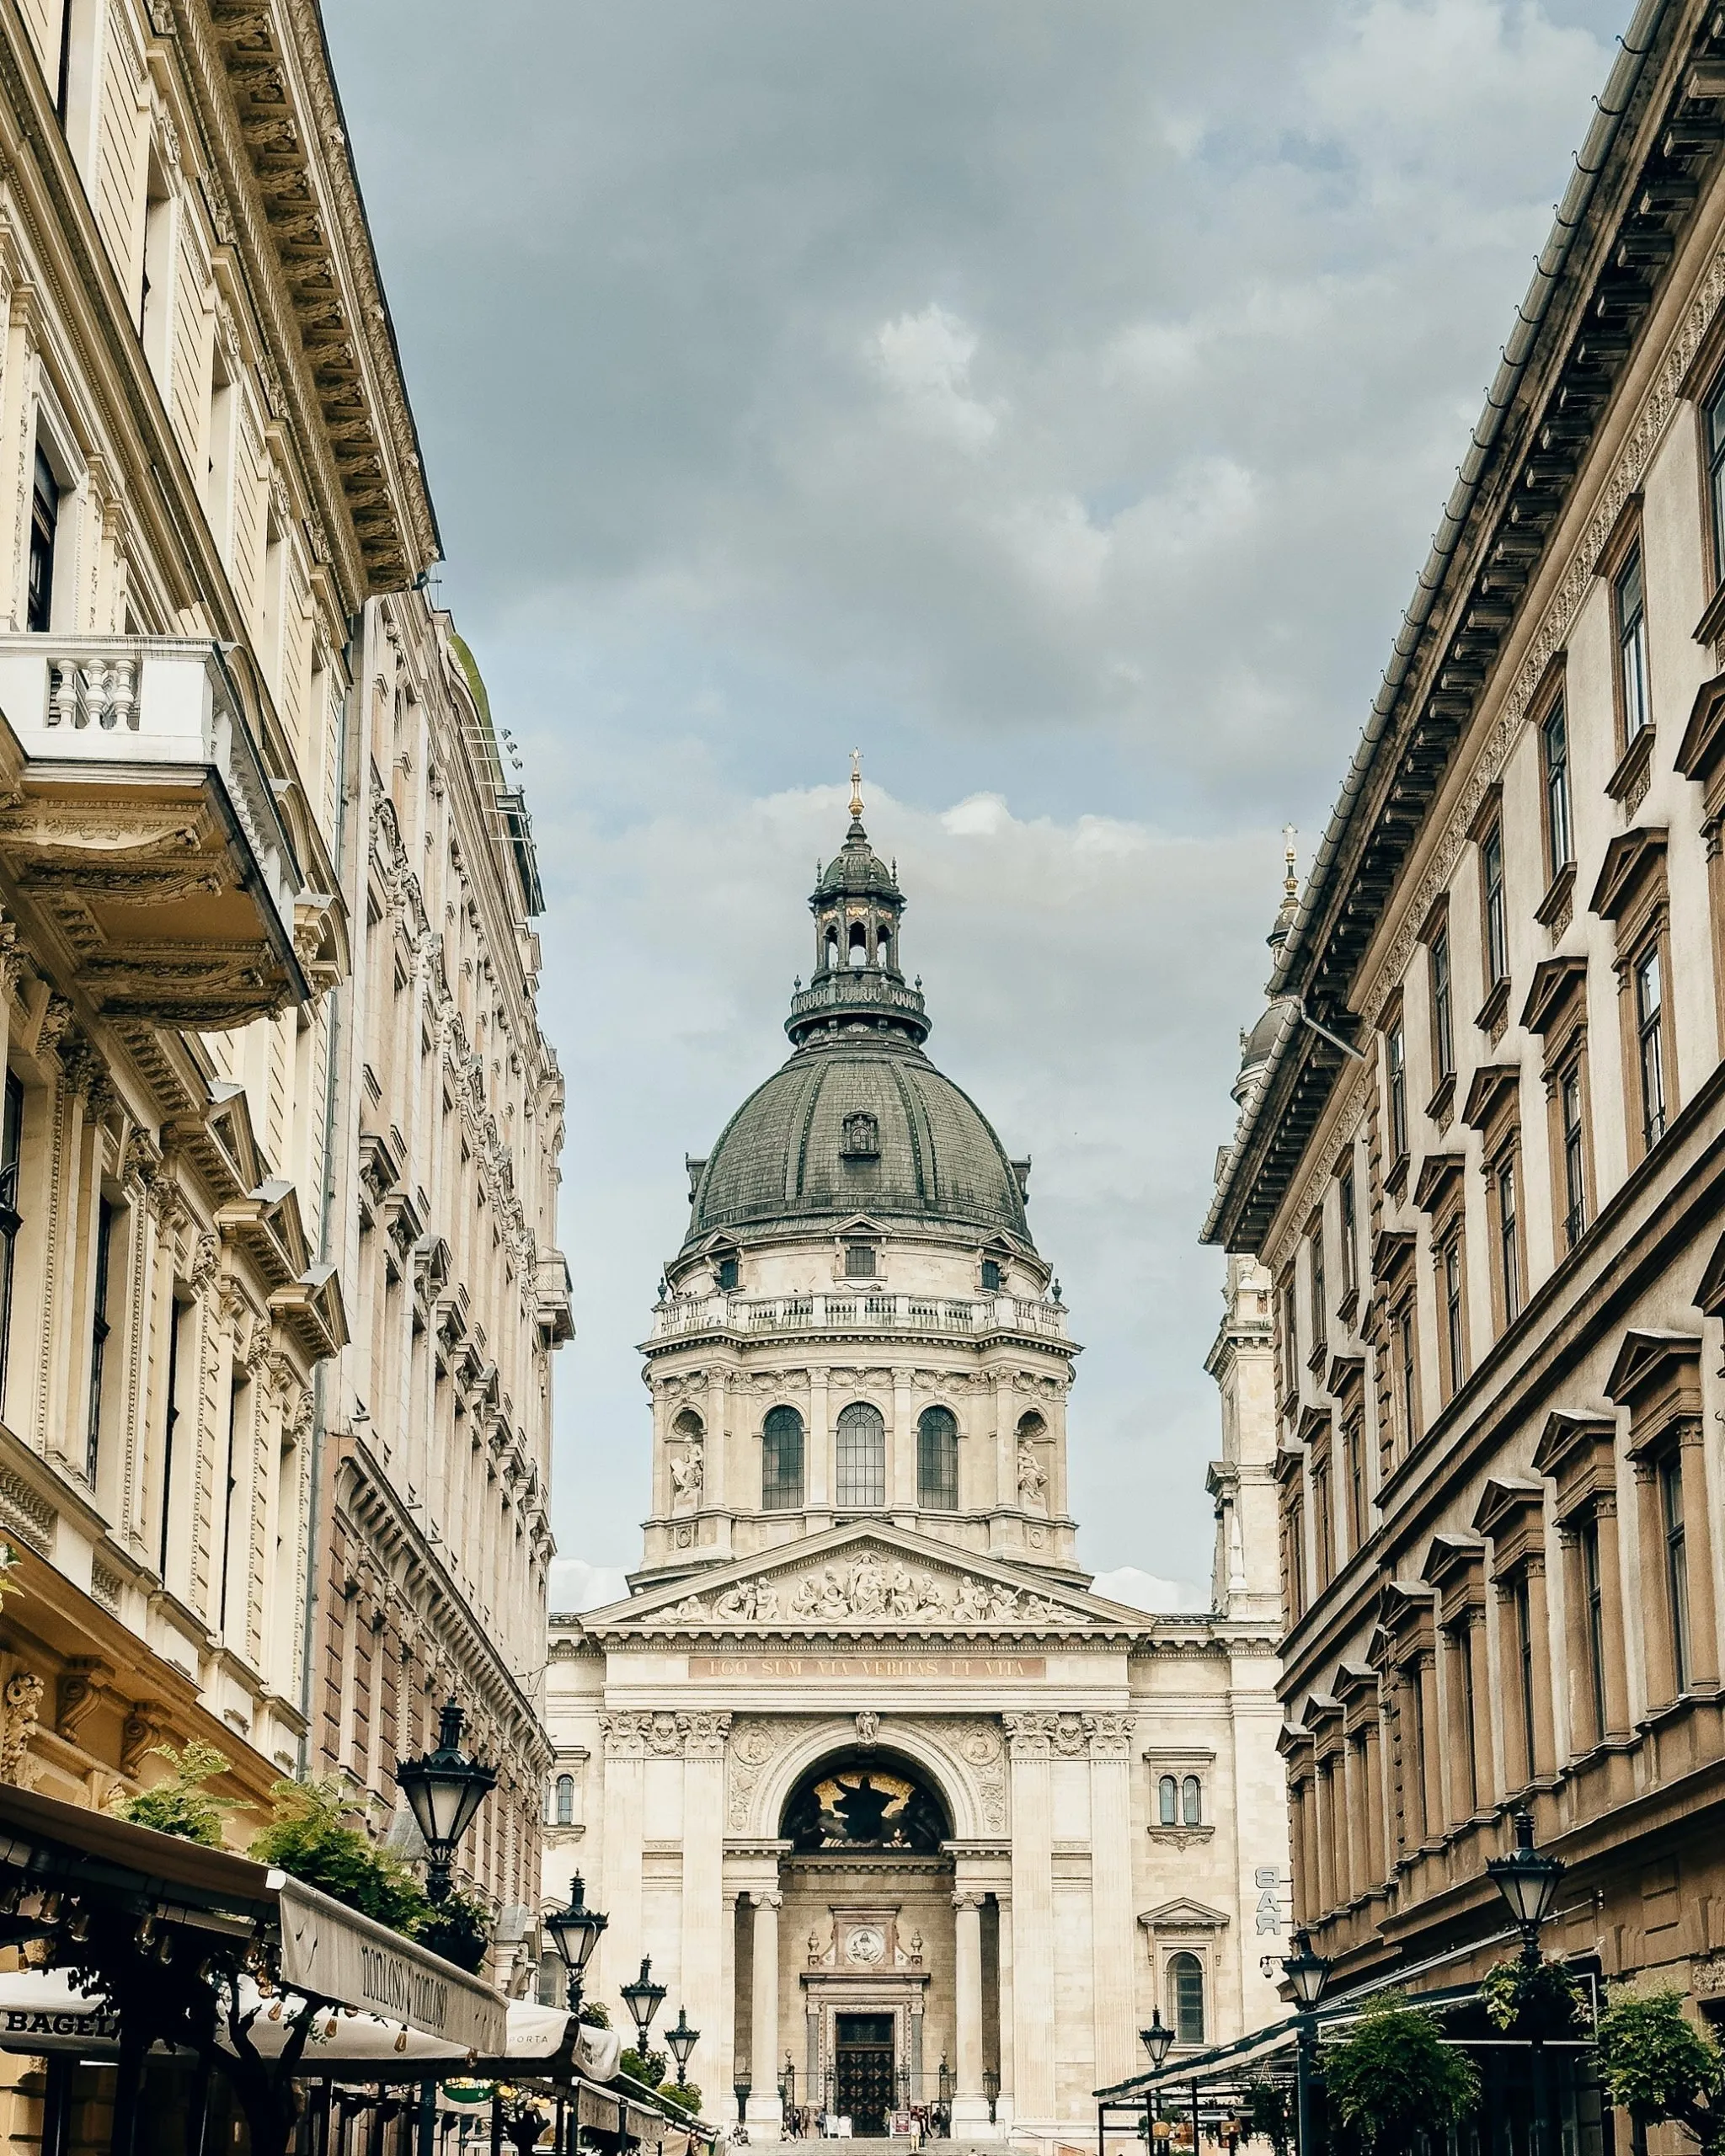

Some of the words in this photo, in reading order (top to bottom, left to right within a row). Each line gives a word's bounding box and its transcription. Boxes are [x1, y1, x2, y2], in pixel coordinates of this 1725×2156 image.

[709, 1661, 748, 1676] EGO
[761, 1661, 802, 1676] SUM
[816, 1661, 849, 1676] VIA
[862, 1661, 938, 1676] VERITAS
[951, 1661, 972, 1676] ET
[985, 1661, 1025, 1676] VITA
